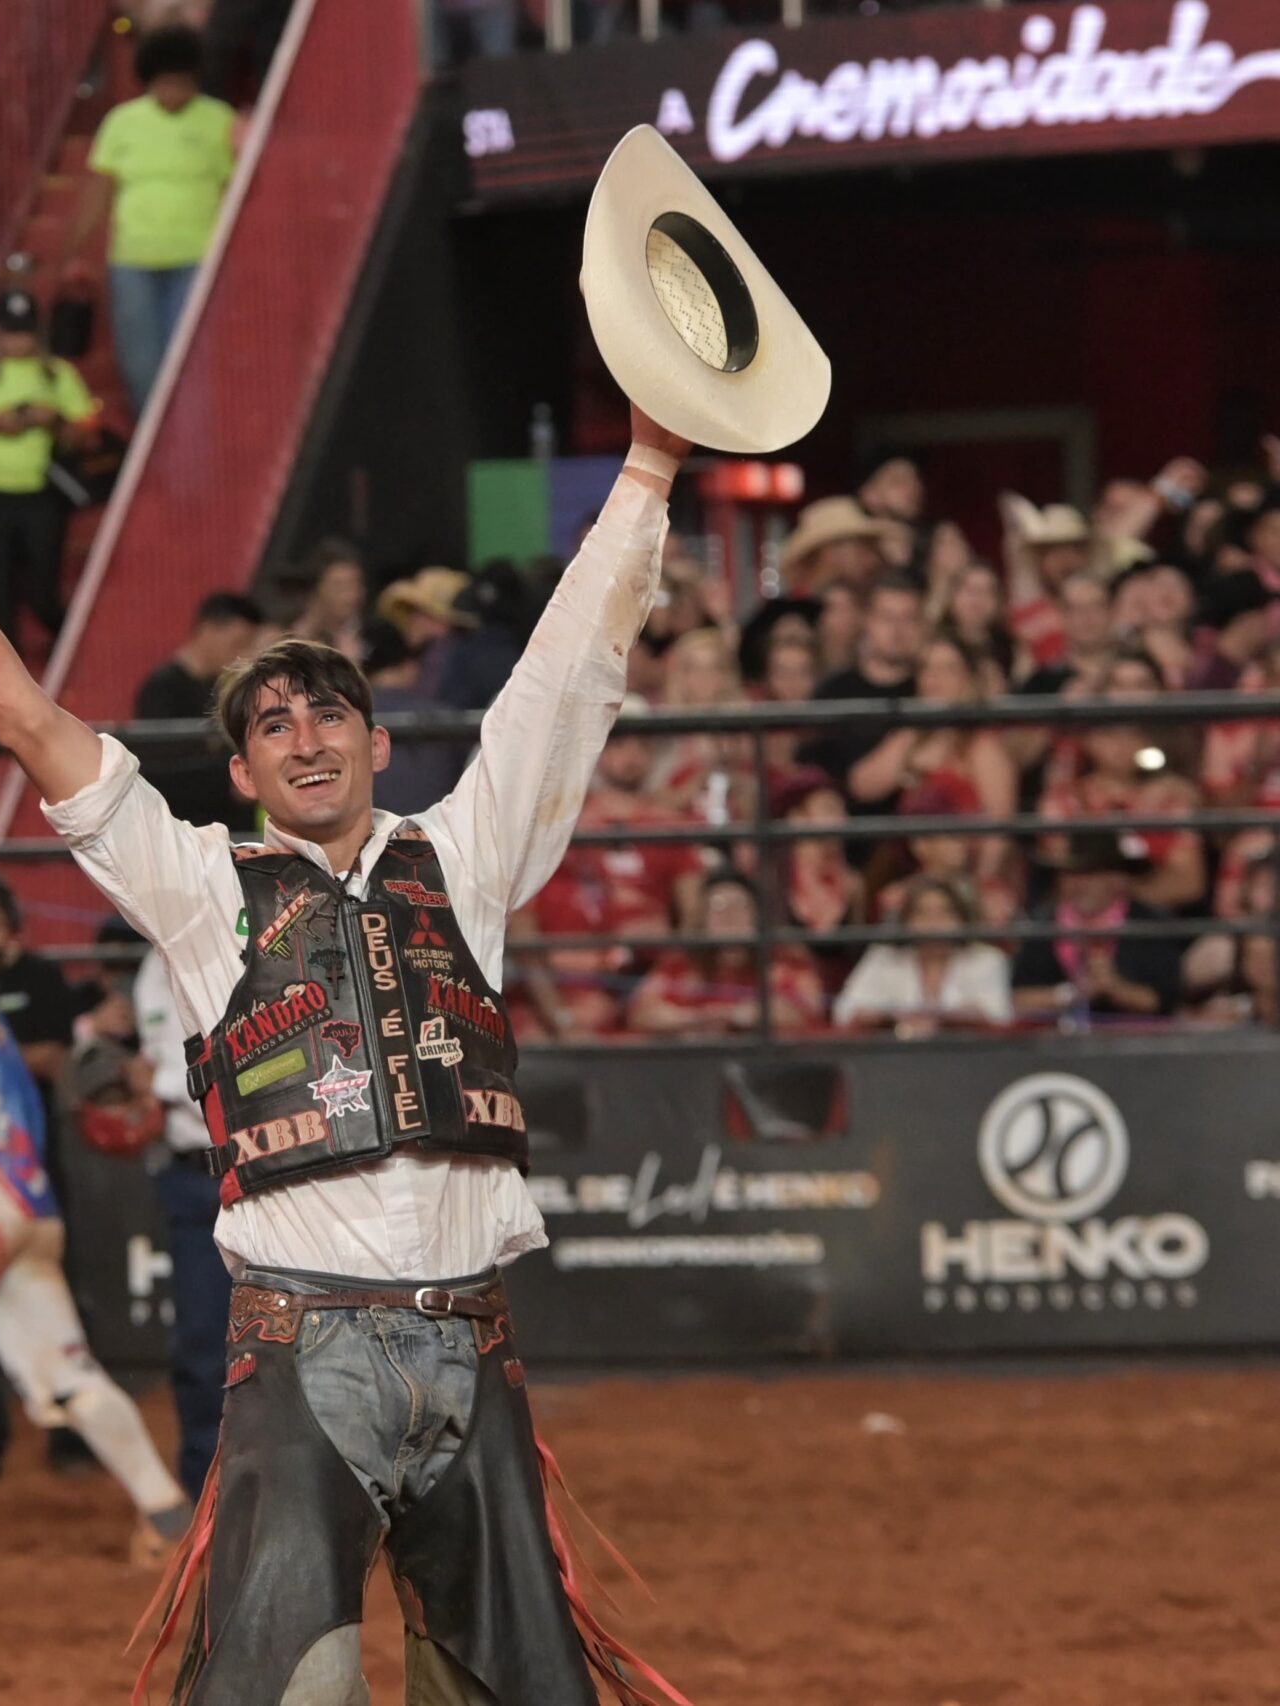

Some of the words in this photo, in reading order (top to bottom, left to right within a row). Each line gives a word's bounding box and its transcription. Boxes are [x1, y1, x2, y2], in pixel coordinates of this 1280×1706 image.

[707, 0, 1280, 163] Cremosidade
[361, 914, 397, 990] DEUS
[403, 948, 454, 961] MITSUBISHI
[413, 959, 451, 970] MOTORS
[234, 1039, 277, 1070] BRUTOS
[286, 1007, 332, 1037] BRUTAS
[381, 1009, 406, 1037] É
[419, 1042, 460, 1057] BRIMEX
[388, 1055, 421, 1131] FIEL
[230, 1111, 326, 1166] XBB
[922, 1212, 1211, 1282] HENKO
